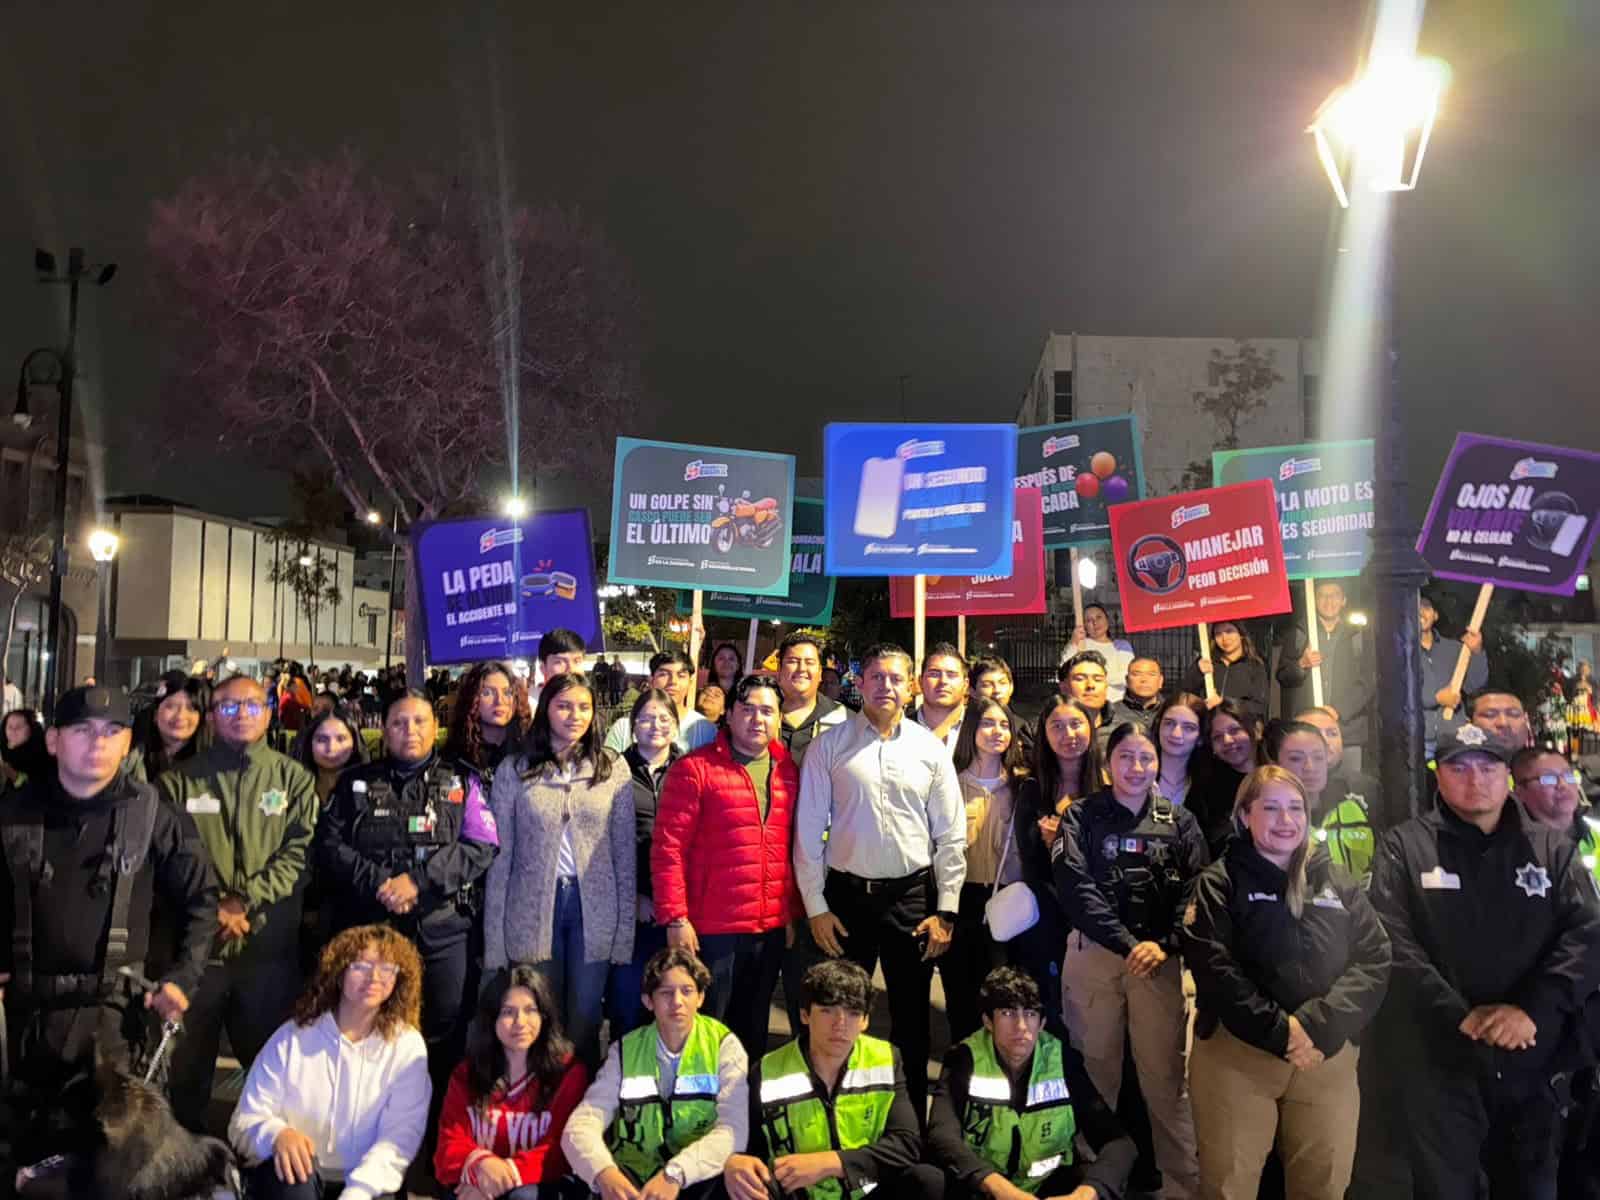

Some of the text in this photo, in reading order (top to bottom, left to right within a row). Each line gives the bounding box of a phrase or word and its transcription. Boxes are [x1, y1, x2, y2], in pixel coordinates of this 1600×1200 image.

[629, 493, 714, 511] UN GOLPE SIN
[1281, 481, 1373, 511] LA MOTO ES
[1457, 482, 1534, 511] OJOS AL
[626, 520, 711, 544] EL ÚLTIMO
[1184, 525, 1264, 562] MANEJAR
[442, 560, 515, 595] LA PEDA
[1188, 571, 1216, 590] PEOR
[1219, 557, 1270, 584] DECISIÓN
[446, 613, 457, 626] EL
[458, 604, 503, 625] ACCIDENTE
